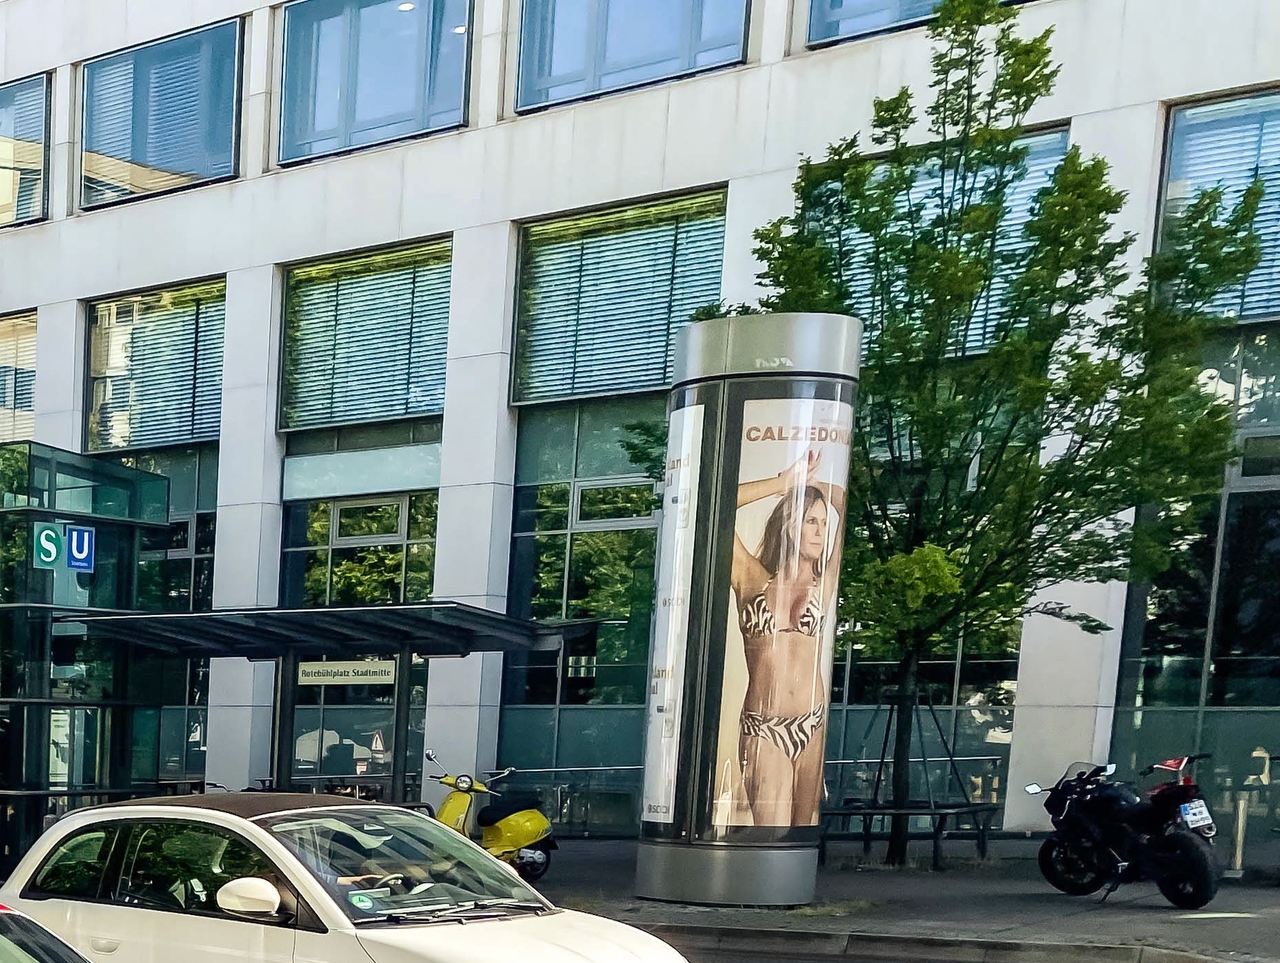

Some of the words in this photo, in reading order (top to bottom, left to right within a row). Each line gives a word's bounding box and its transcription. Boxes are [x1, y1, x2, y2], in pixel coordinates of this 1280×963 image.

[40, 529, 57, 562] S
[72, 531, 89, 559] U
[301, 669, 350, 679] Rotebühlplatz
[352, 668, 391, 677] Stadtmitte
